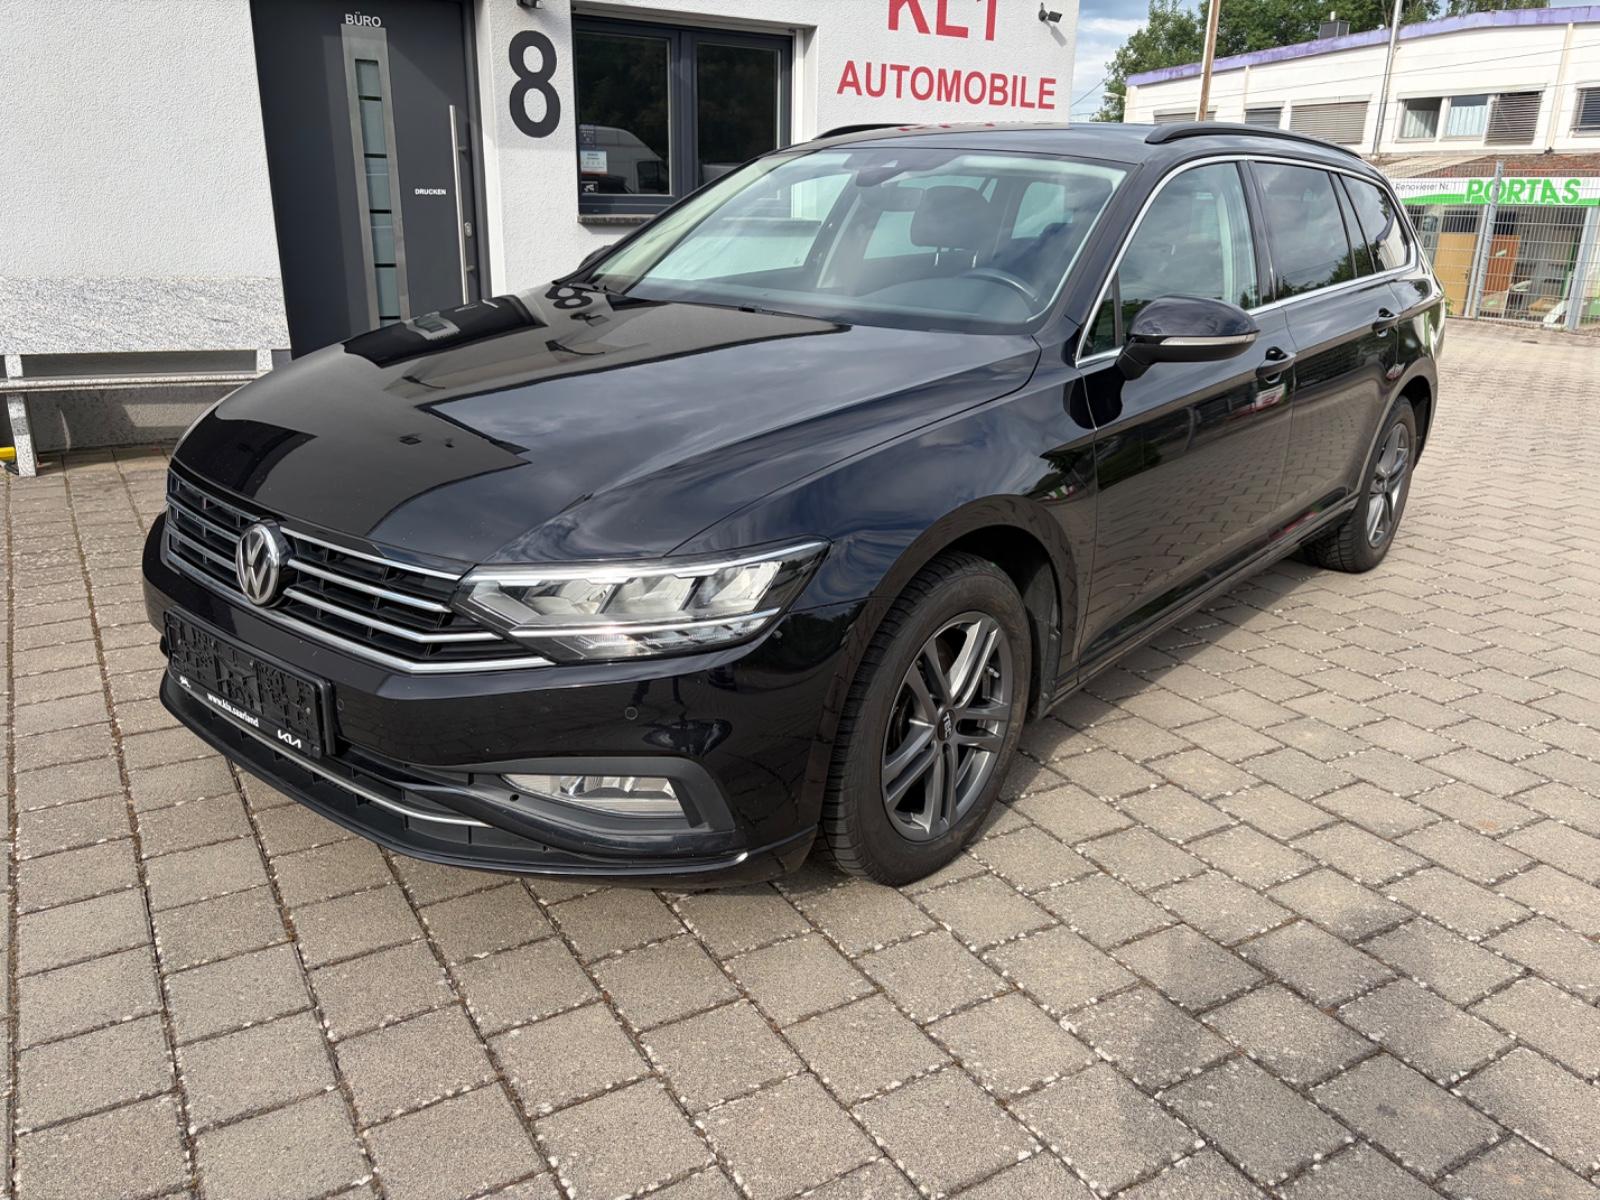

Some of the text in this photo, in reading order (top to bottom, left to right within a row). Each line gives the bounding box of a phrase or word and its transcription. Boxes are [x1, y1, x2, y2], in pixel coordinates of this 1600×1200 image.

[345, 11, 381, 27] BÜRO
[508, 30, 561, 138] 8
[836, 60, 1056, 110] AUTOMOBILE
[1466, 178, 1581, 204] PORTAS
[207, 692, 259, 728] www.kia.saarland
